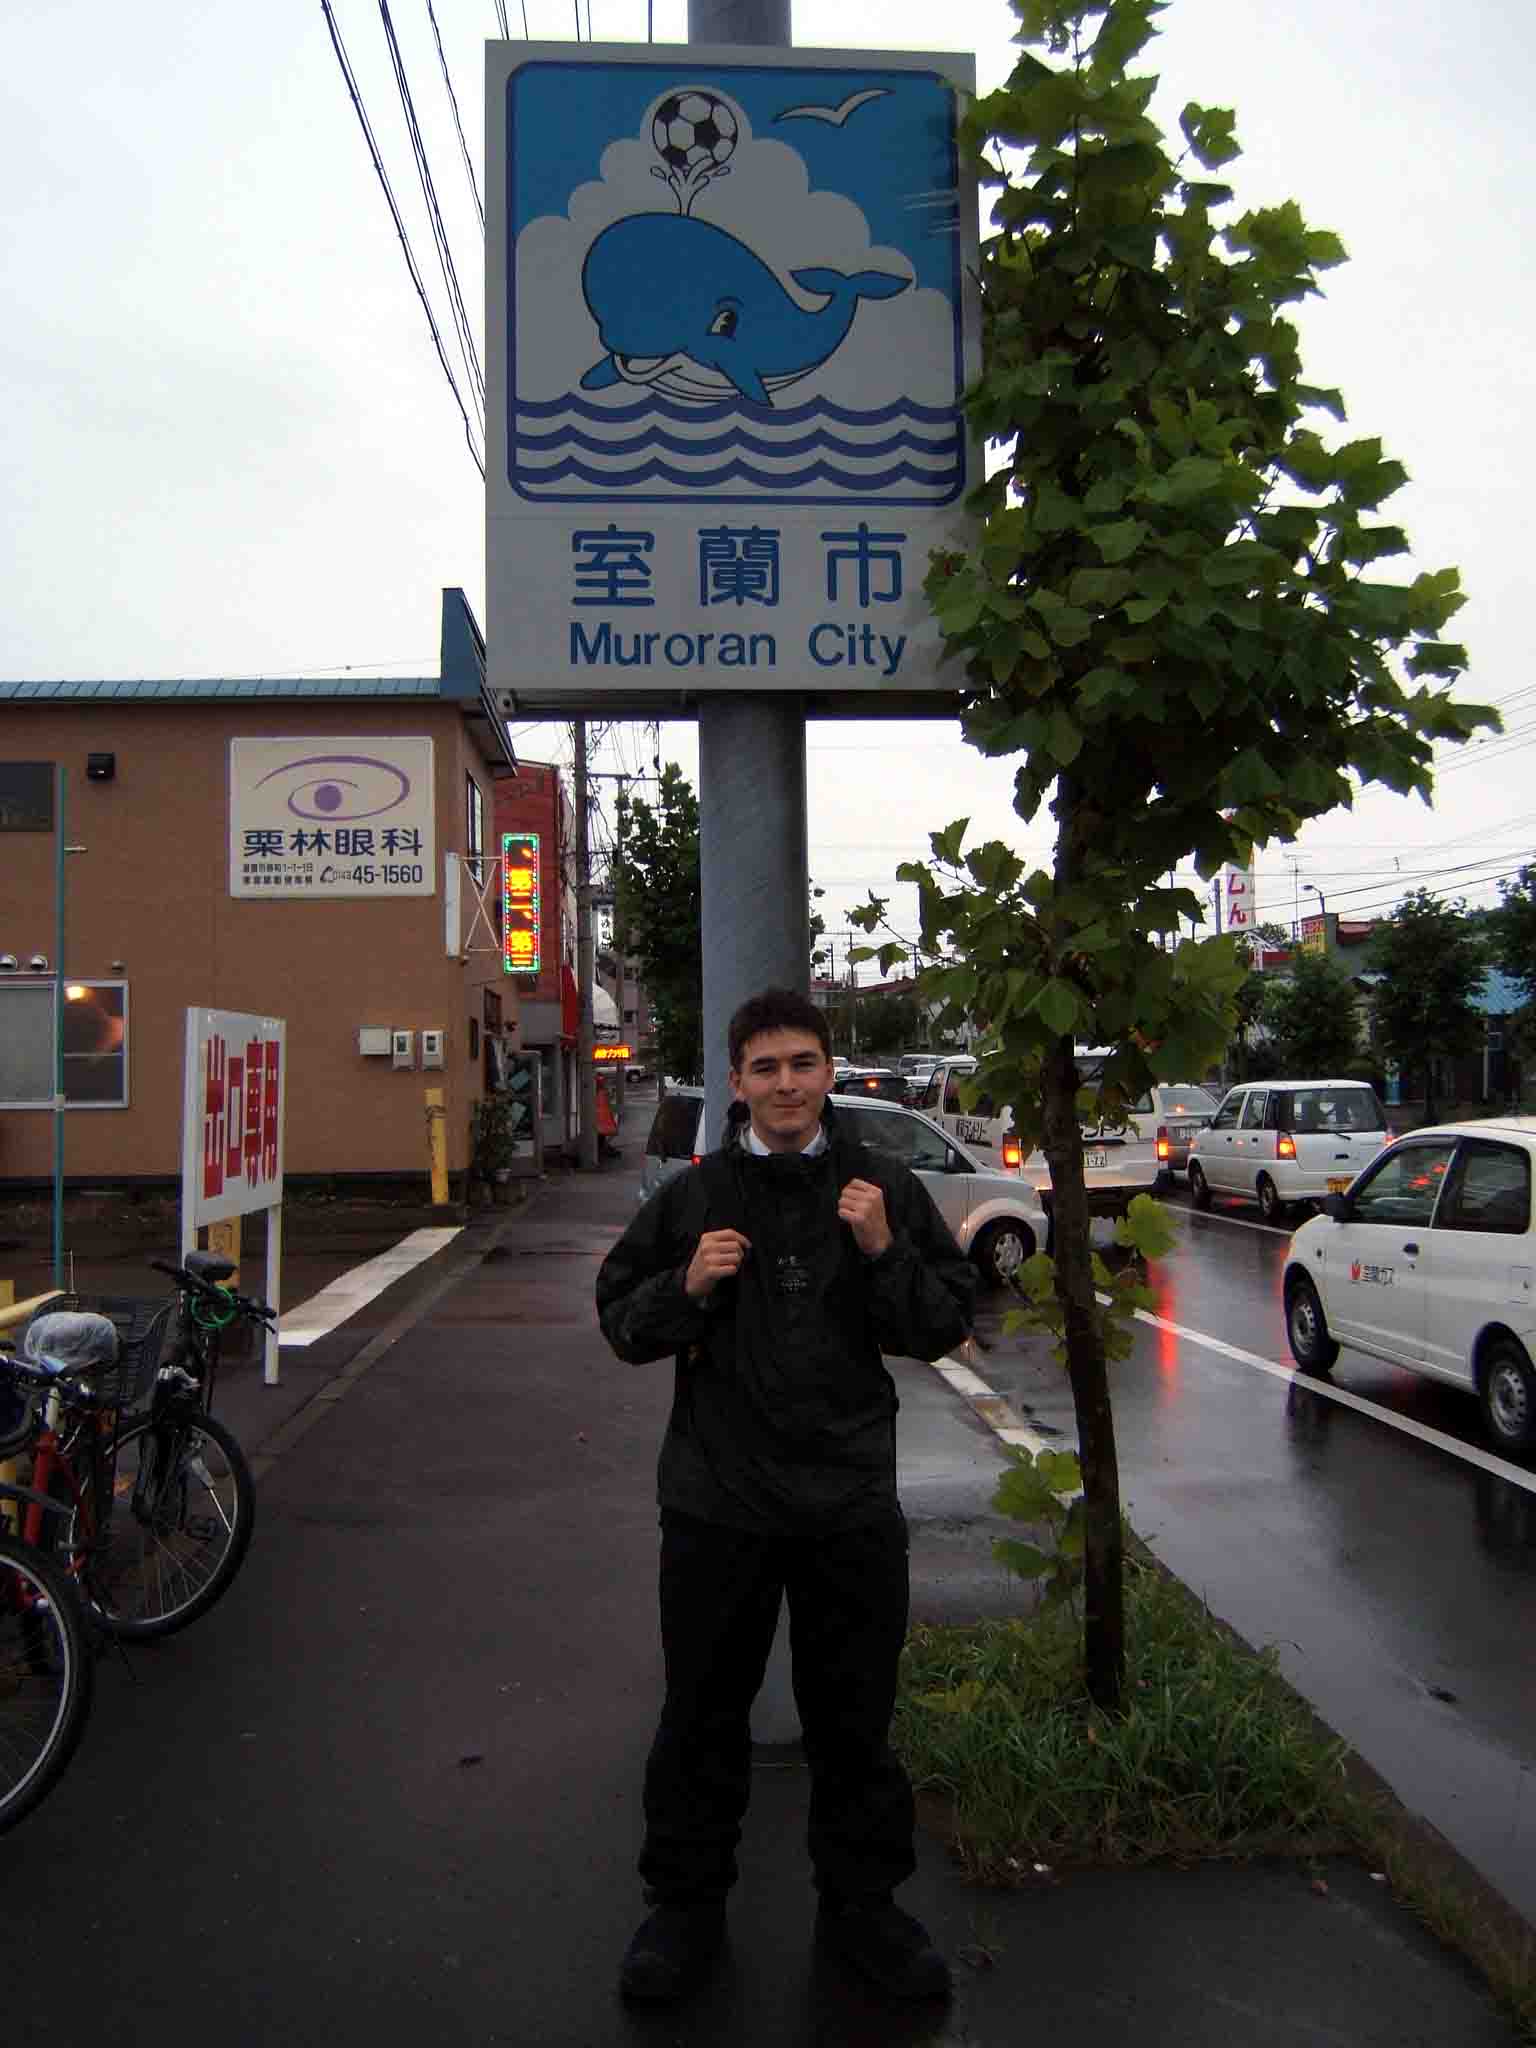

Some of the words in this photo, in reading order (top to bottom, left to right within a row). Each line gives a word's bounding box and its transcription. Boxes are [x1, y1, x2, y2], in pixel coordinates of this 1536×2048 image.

[571, 521, 907, 608] 室蘭市
[570, 622, 776, 666] Muroran
[808, 623, 907, 675] City
[243, 828, 423, 858] 栗林眼科
[352, 864, 423, 884] 45-1560
